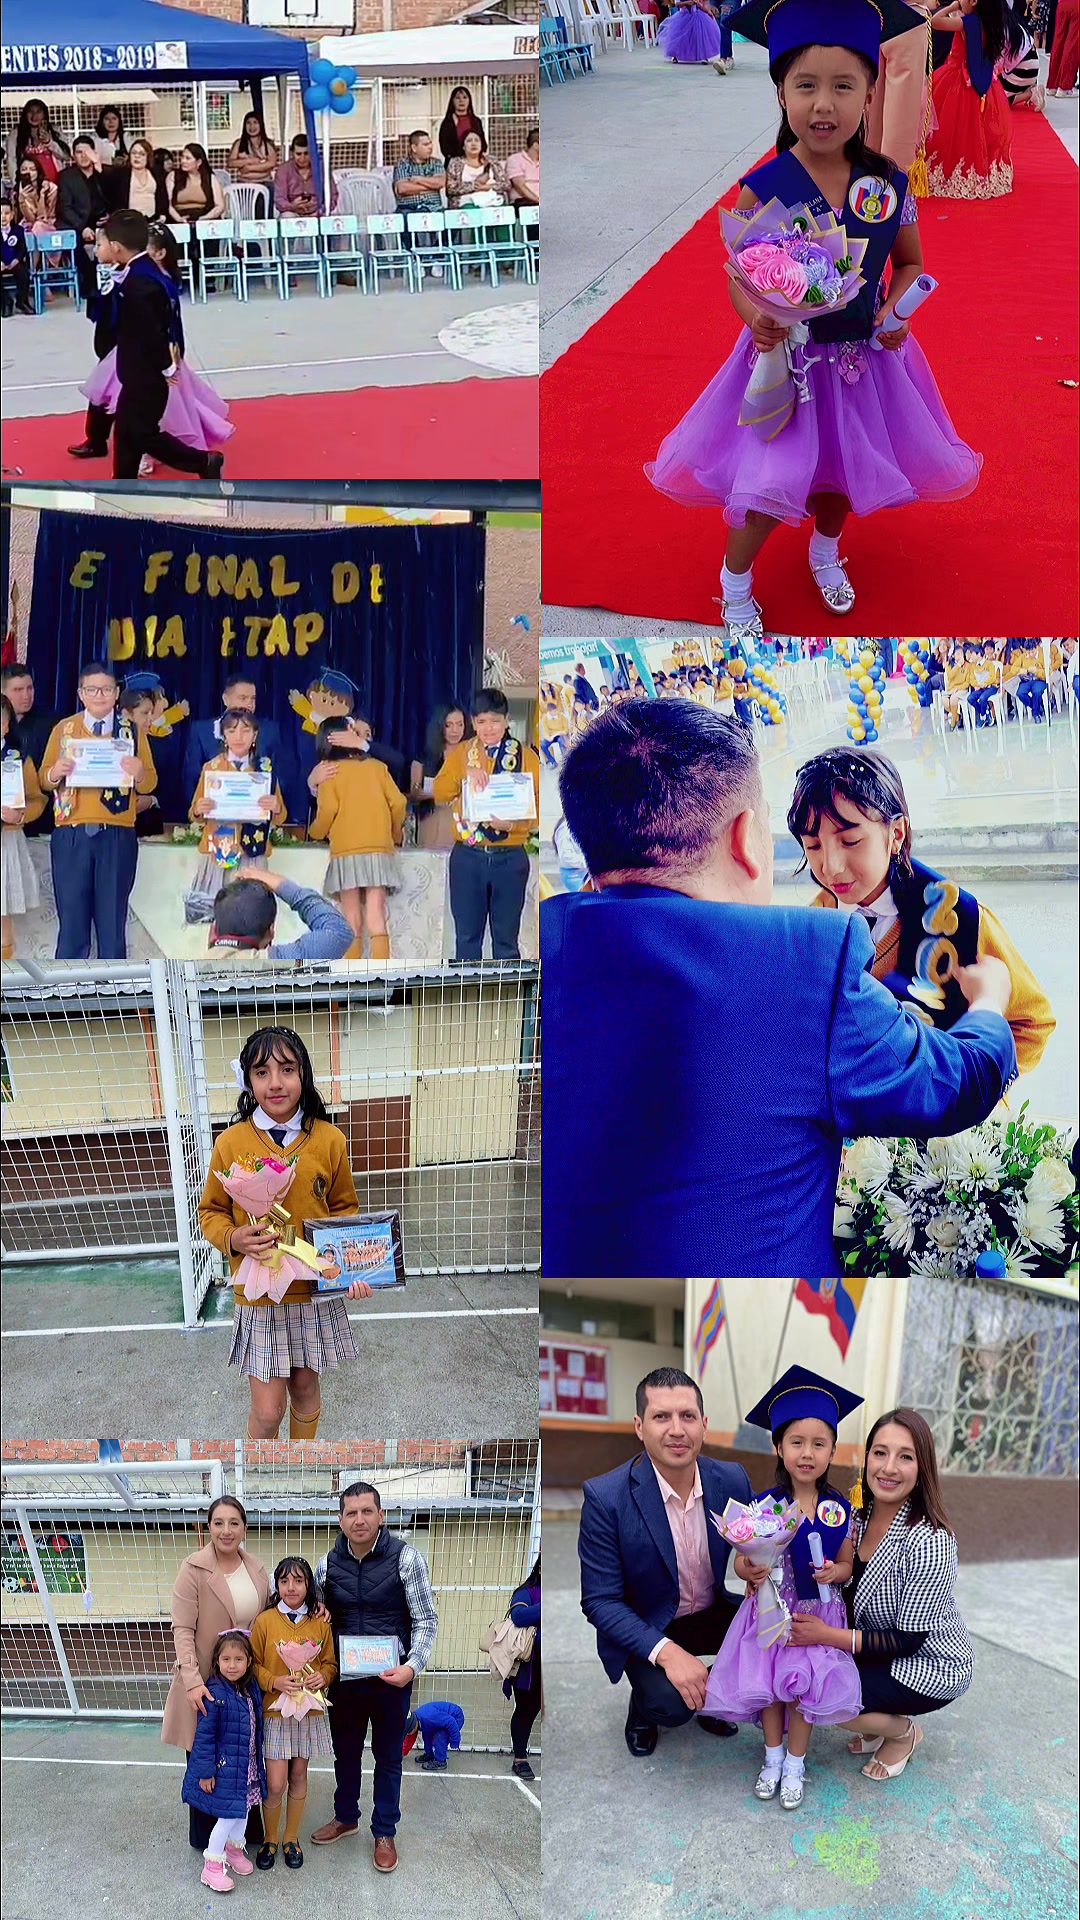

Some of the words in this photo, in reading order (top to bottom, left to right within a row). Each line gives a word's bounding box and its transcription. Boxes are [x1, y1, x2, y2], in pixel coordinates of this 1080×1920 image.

[64, 46, 102, 71] 2018
[116, 45, 154, 69] 2019
[144, 551, 300, 600] FINAL
